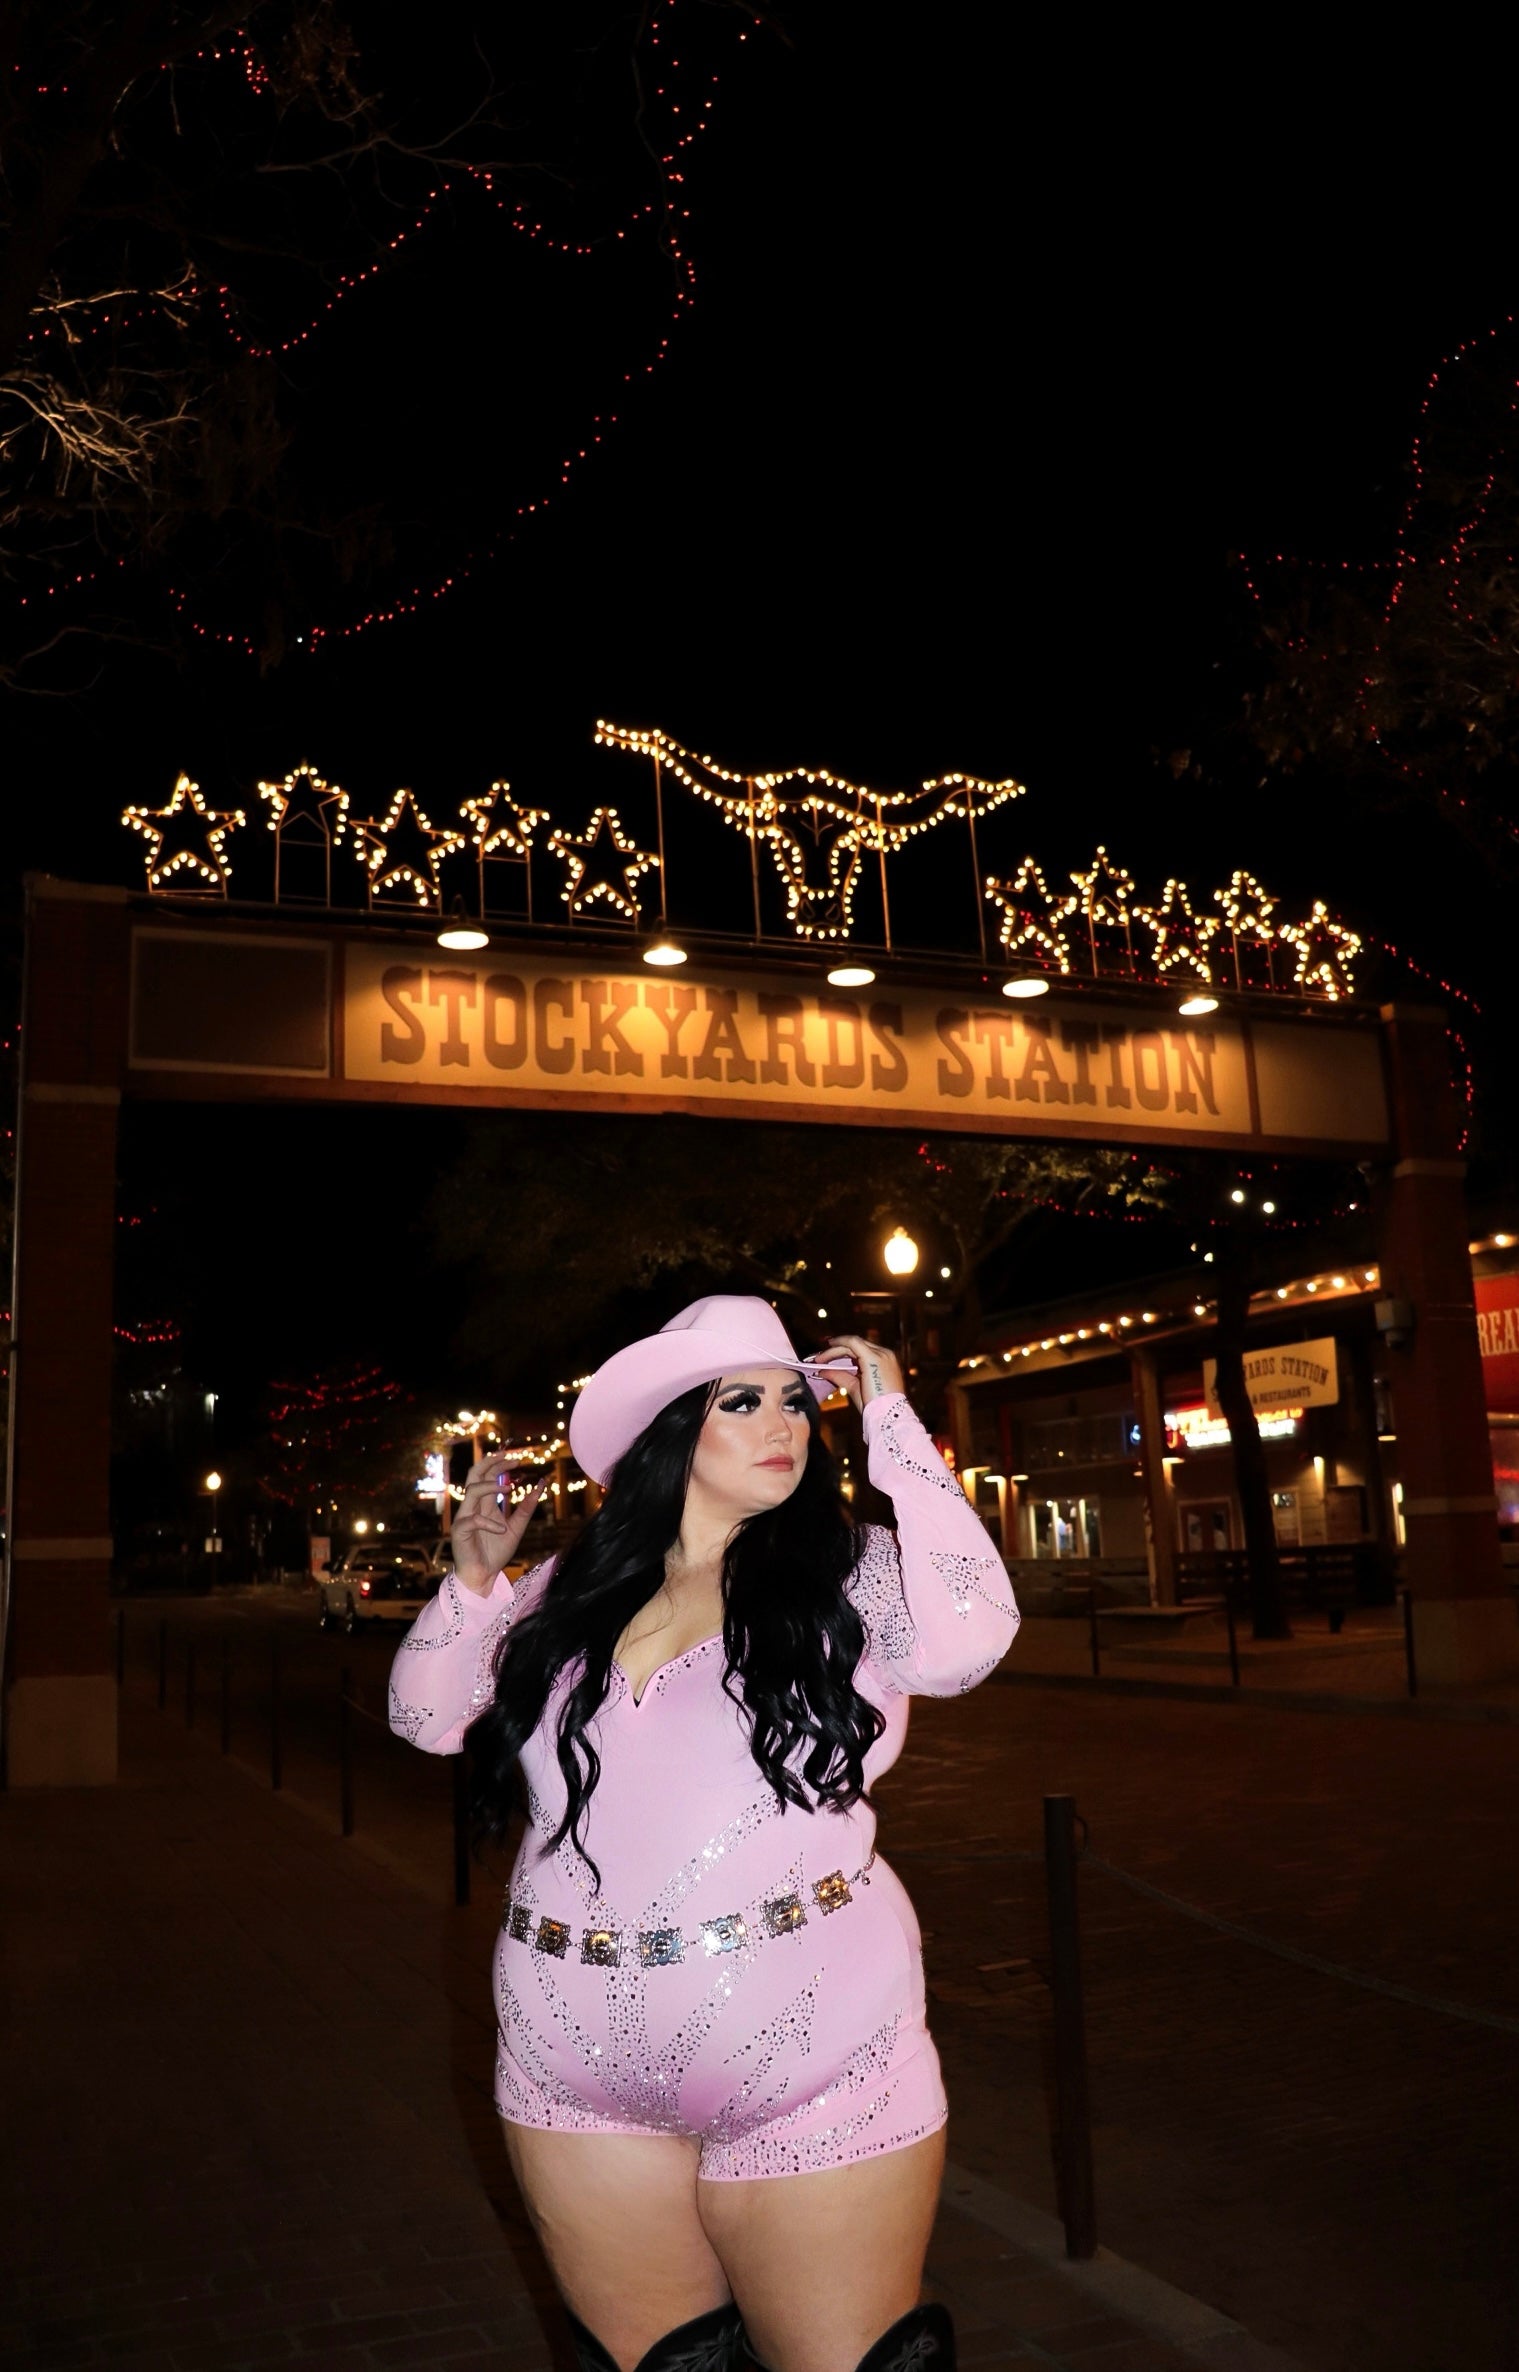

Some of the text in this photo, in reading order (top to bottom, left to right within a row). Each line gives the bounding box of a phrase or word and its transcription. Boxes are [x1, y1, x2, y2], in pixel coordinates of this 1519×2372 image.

[381, 966, 1220, 1115] STOCKYARDS STATION
[1476, 1307, 1519, 1357] REA
[1281, 1357, 1329, 1386] STATION
[1259, 1386, 1311, 1403] RESTAURANTS
